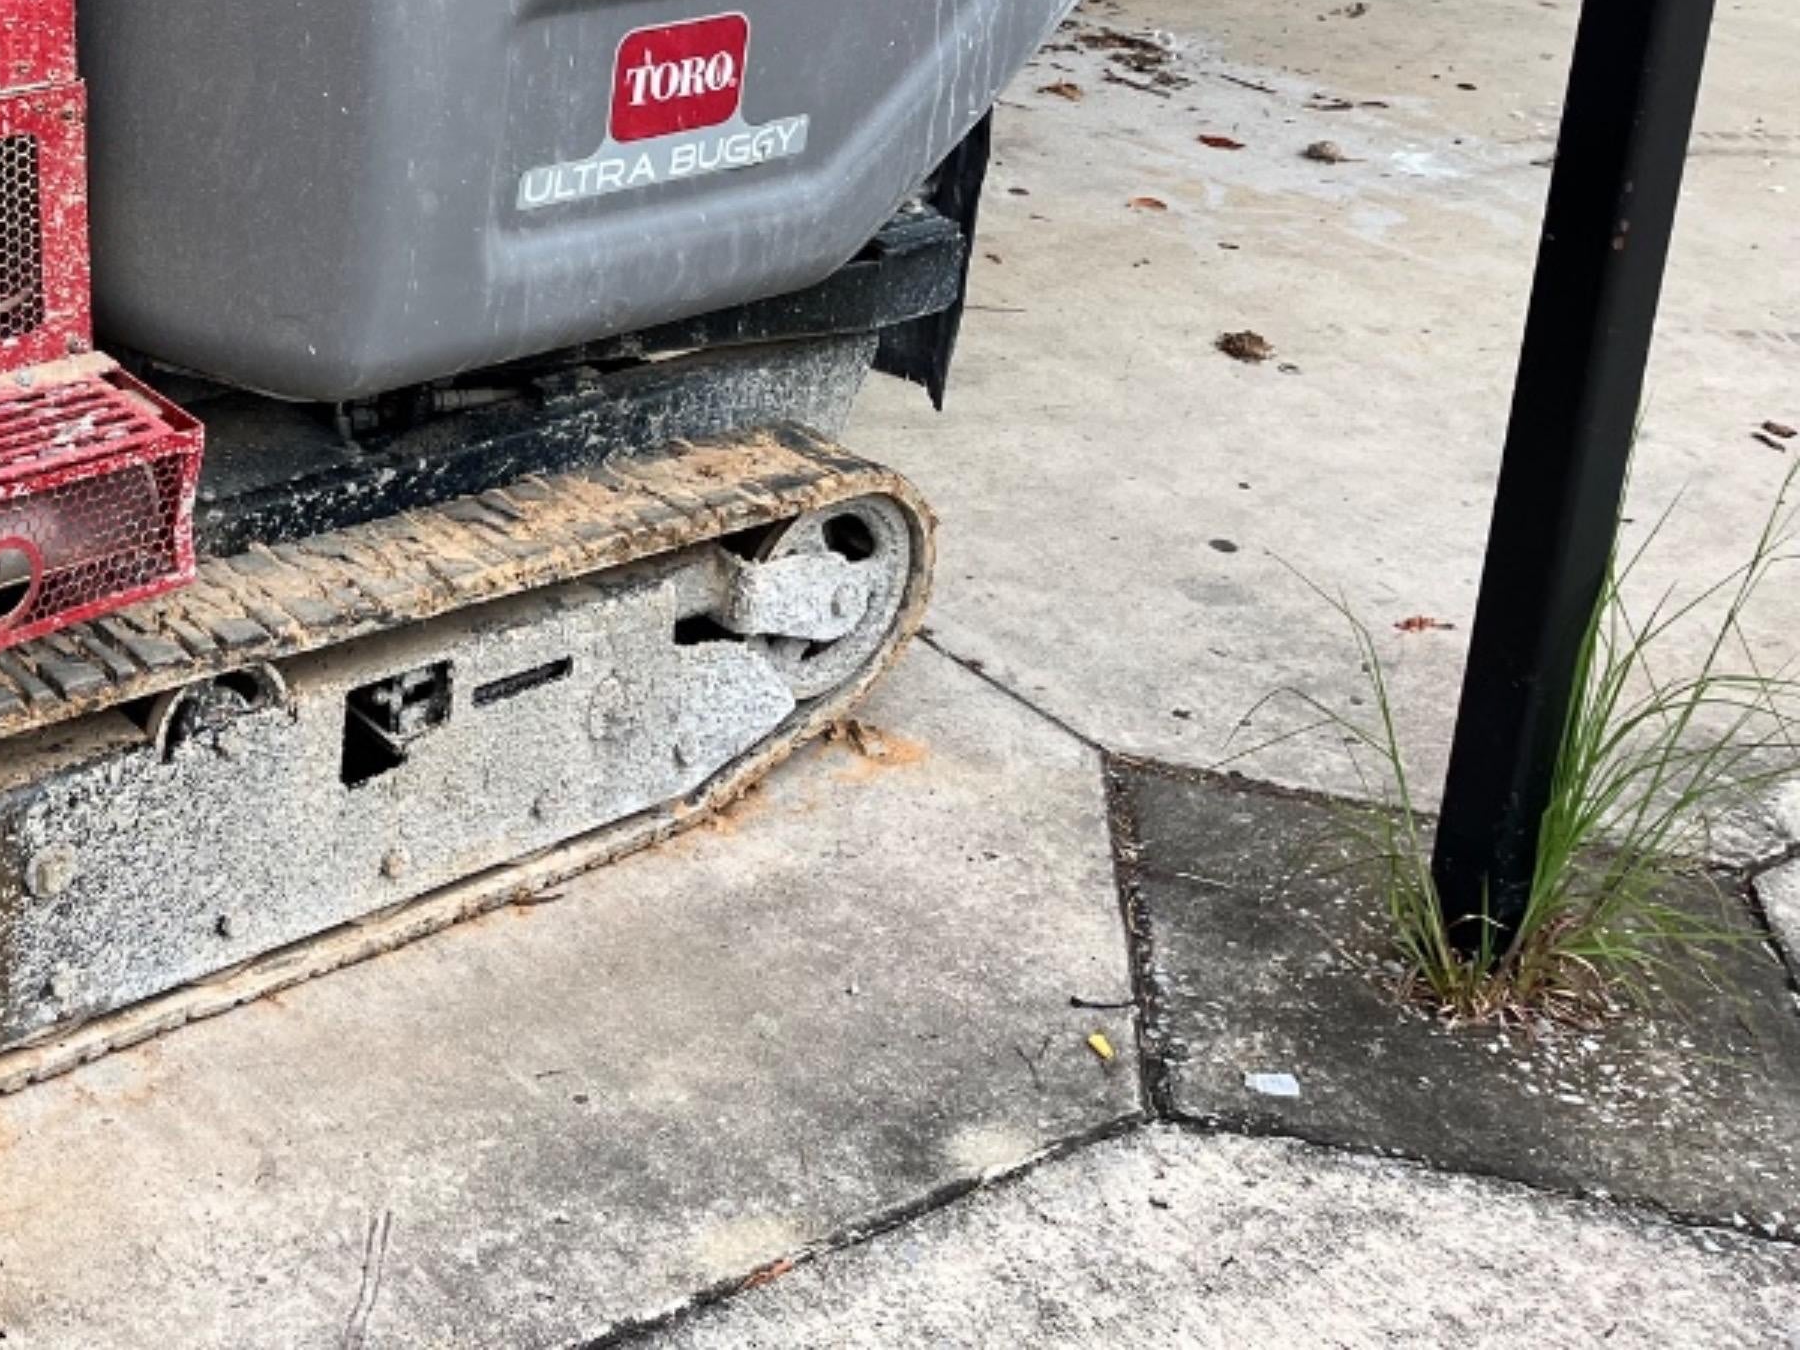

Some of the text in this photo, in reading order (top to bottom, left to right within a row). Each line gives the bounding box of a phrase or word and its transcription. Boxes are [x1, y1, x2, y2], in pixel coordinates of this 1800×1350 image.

[625, 50, 735, 106] TORO
[524, 121, 798, 203] ULTRA BUGGY
